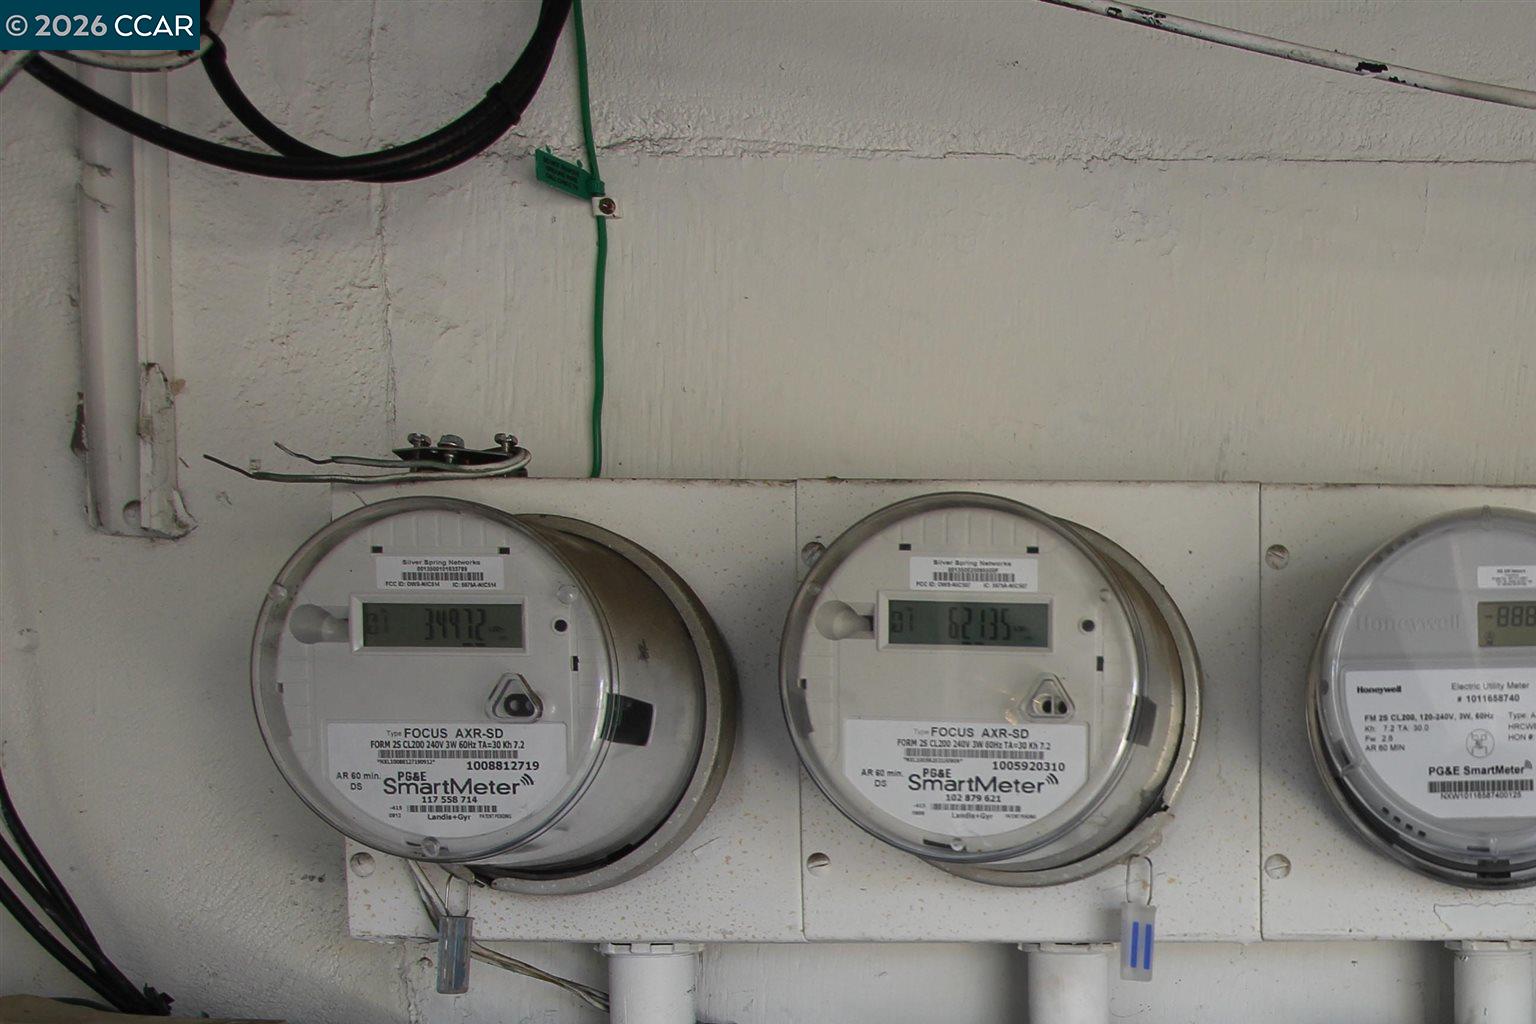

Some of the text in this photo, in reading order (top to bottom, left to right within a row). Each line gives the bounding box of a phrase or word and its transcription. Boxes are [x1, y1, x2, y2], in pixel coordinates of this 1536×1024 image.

[1357, 685, 1402, 694] Honeywell
[1451, 682, 1481, 690] Electric
[1483, 682, 1504, 691] Utility
[405, 729, 448, 738] FOCUS
[456, 729, 503, 738] AXR-SD
[931, 727, 1029, 739] FOCUS AXR-SD
[503, 741, 512, 749] Kh
[514, 741, 525, 749] 7.2
[467, 761, 539, 770] 1008812719
[992, 761, 1065, 771] 1005920310
[923, 768, 951, 778] PG&E
[1428, 765, 1524, 776] PG&E SmartMeter
[398, 772, 426, 781] PG&E
[384, 778, 520, 795] SmartMeter
[908, 774, 1045, 793] SmartMeter
